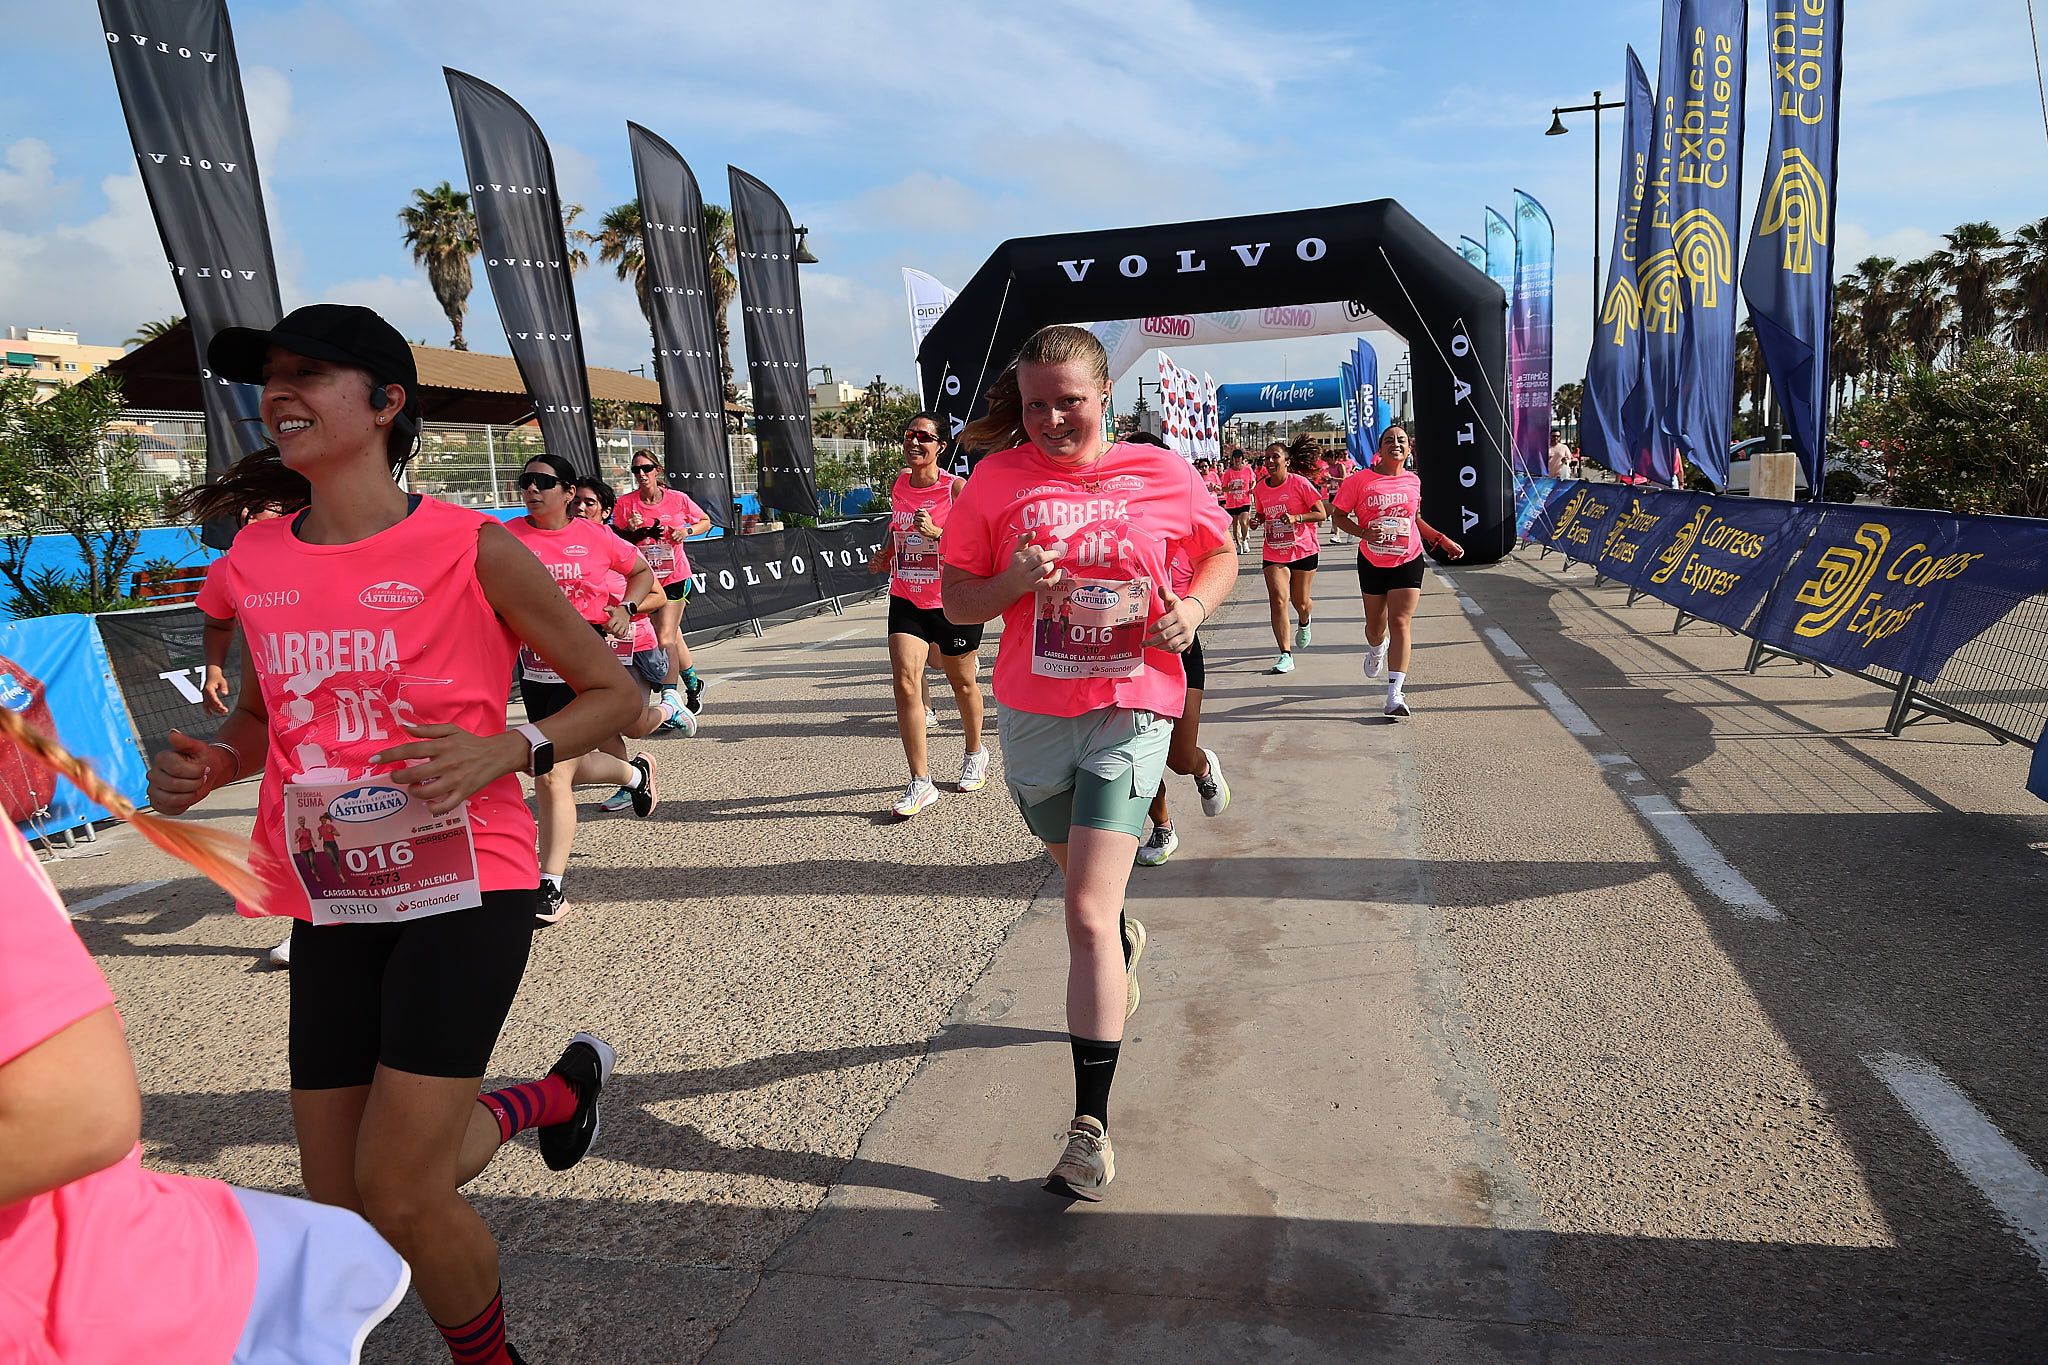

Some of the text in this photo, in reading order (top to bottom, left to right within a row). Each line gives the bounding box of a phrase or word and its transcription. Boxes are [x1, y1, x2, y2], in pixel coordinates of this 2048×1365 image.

[1057, 237, 1328, 282] VOLVO
[1144, 315, 1191, 337] COSMO
[1264, 306, 1312, 328] COSMO
[1260, 382, 1315, 408] Marlene
[1451, 334, 1479, 534] VOLVO
[1016, 485, 1064, 499] OYSHO
[1367, 493, 1409, 507] CARRERA
[1022, 499, 1129, 530] CARRERA
[1701, 516, 1766, 559] Correos
[904, 553, 923, 562] 016
[1078, 530, 1112, 568] DE
[546, 562, 583, 580] RERA
[692, 555, 806, 594] VOLVO
[1681, 553, 1740, 596] Express
[244, 589, 301, 609] OYSHO
[363, 591, 419, 603] ASTURIANA
[1070, 624, 1114, 643] 016
[1044, 650, 1069, 659] CARRERA
[1044, 662, 1080, 673] OYSHO
[1100, 665, 1133, 673] Santander
[330, 687, 389, 742] DE
[297, 798, 325, 808] SUMA
[334, 796, 403, 817] ASTURIANA
[415, 829, 465, 846] CORREDORA
[345, 840, 415, 873] 016
[322, 872, 459, 897] CARRERA DE LA MUJER VALENCIA
[367, 872, 401, 887] 2573
[330, 903, 378, 915] OYSHO
[410, 893, 460, 910] Santander
